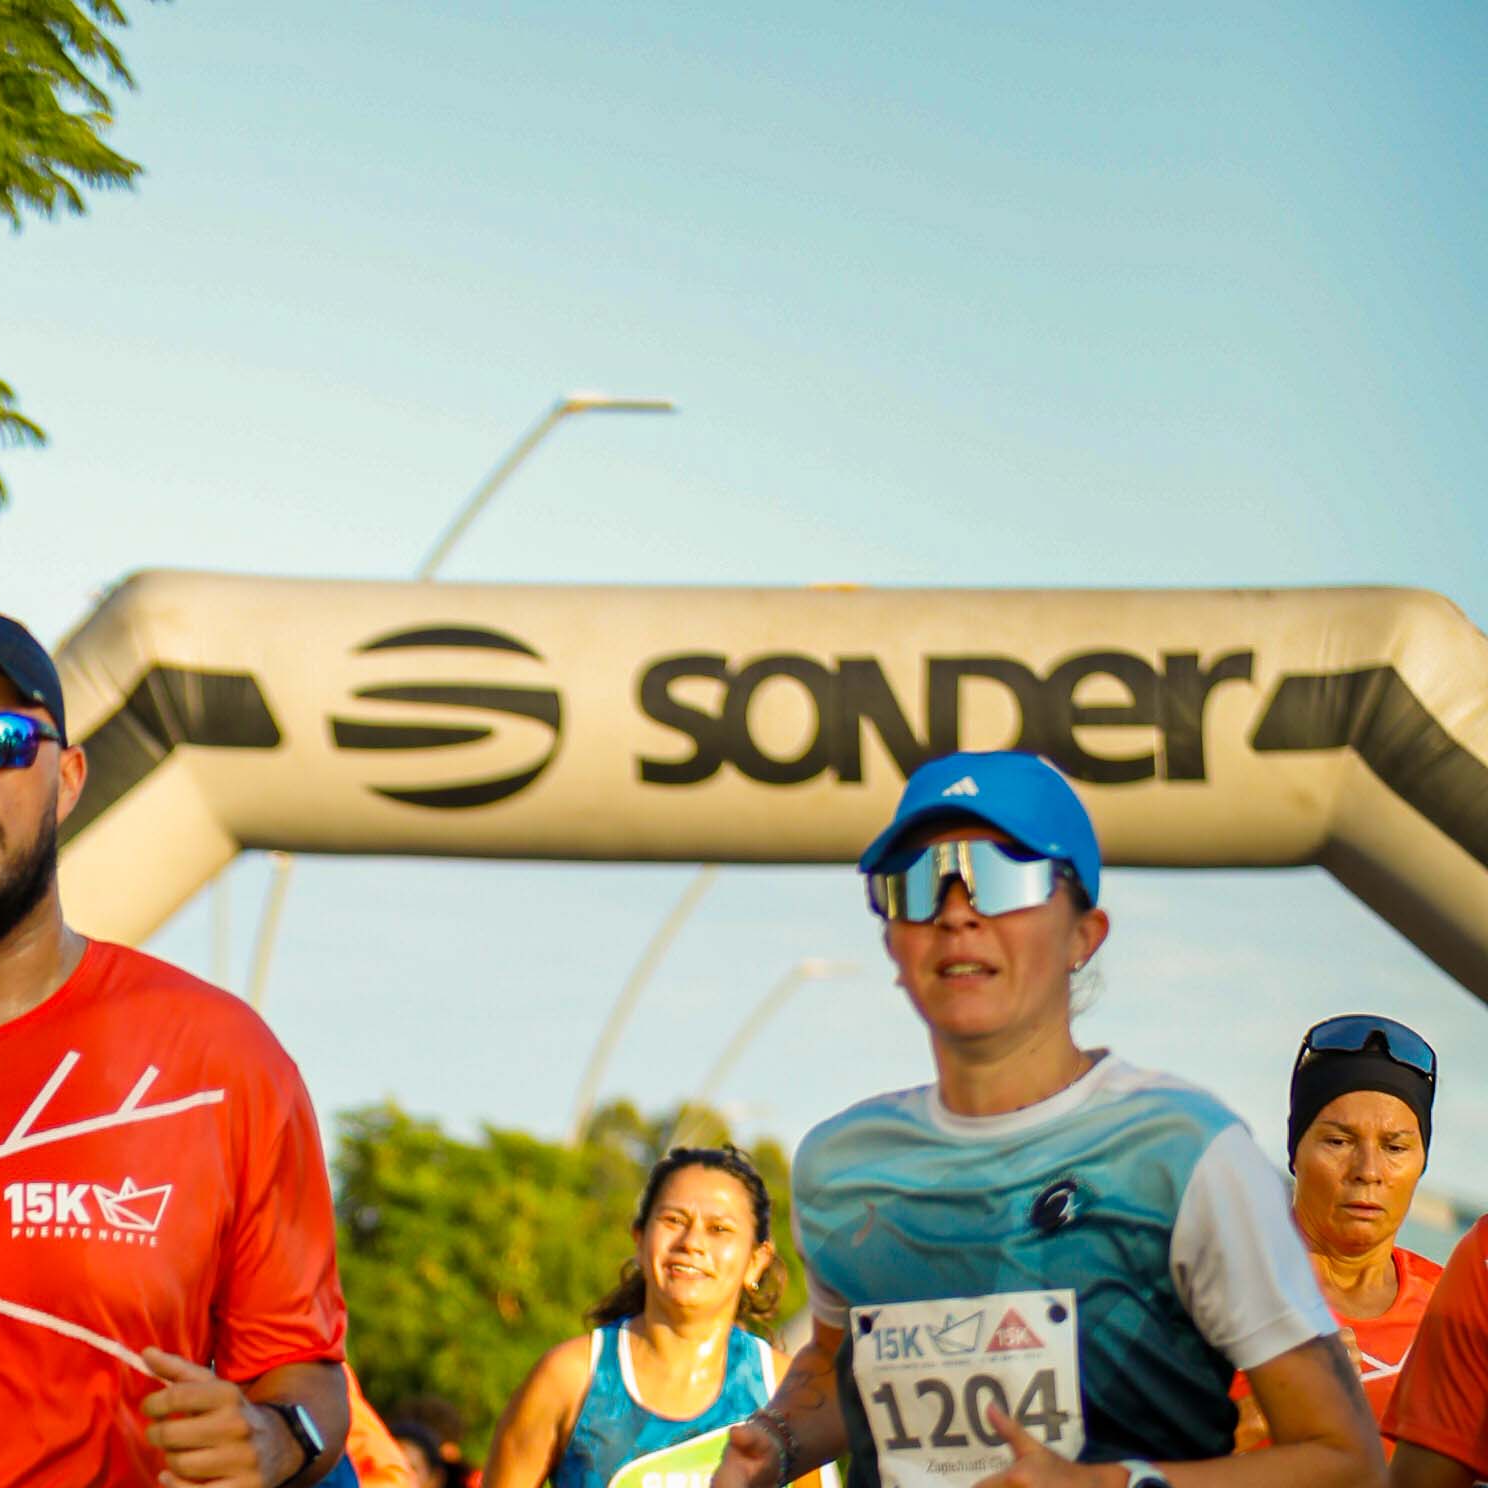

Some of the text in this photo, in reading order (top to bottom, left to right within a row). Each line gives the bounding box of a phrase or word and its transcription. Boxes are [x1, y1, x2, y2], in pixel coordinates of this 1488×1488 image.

[4, 1182, 92, 1225] 15K
[11, 1227, 158, 1247] PUERTO NORTE
[873, 1325, 925, 1361] 15K
[872, 1369, 1069, 1451] 1204
